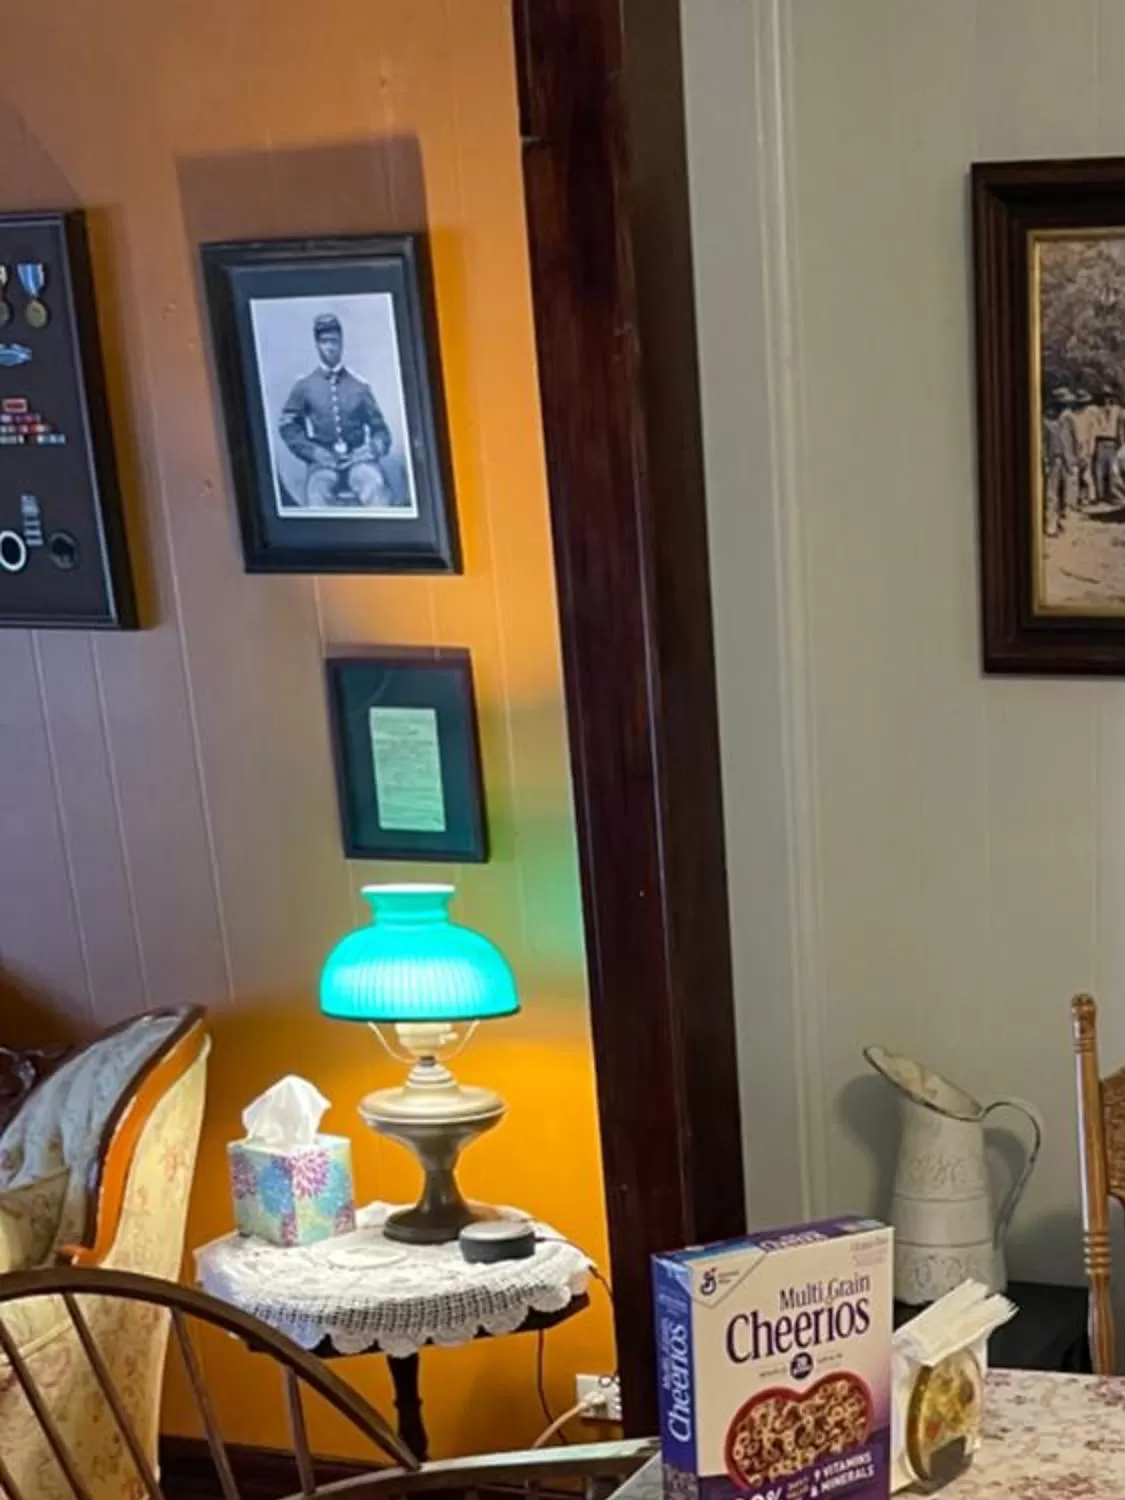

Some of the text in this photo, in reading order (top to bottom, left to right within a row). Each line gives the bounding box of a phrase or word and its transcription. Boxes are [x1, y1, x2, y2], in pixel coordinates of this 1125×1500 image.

[779, 1271, 871, 1312] Multi Grain
[726, 1298, 870, 1364] Cheerios
[668, 1323, 692, 1443] Cheerios
[820, 1464, 875, 1493] MINERALS
[822, 1451, 873, 1479] VITAMINS
